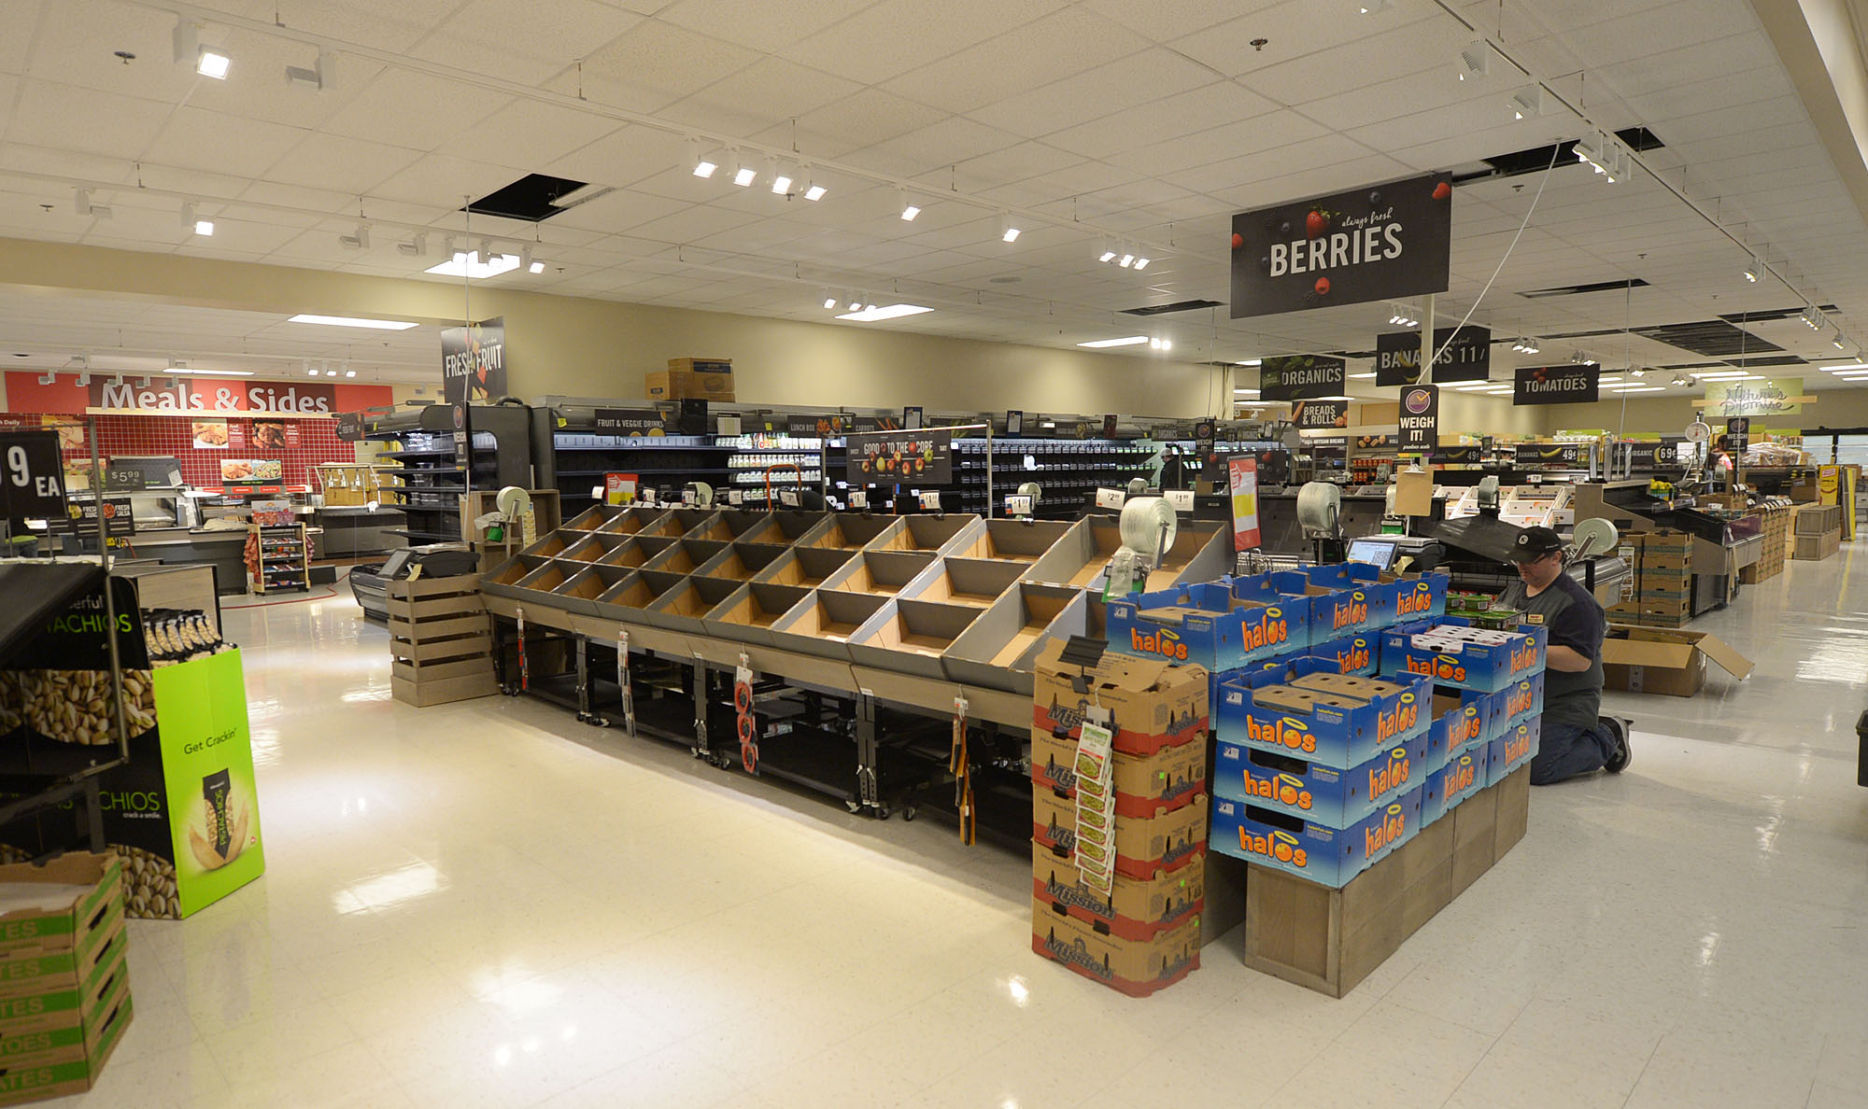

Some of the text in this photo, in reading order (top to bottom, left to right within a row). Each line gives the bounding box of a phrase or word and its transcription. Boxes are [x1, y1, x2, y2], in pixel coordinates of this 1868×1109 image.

[1270, 222, 1403, 278] BERRIES
[445, 344, 502, 378] FRESH FRUIT
[1281, 367, 1342, 386] ORGANICS
[101, 383, 329, 414] Meals & Sides
[1524, 377, 1588, 393] TOMATOES
[597, 418, 615, 428] FRUIT
[616, 420, 622, 428] &
[622, 419, 643, 428] VEGGIE
[1302, 414, 1336, 426] & ROLLS
[1303, 405, 1336, 416] BREADS
[1400, 416, 1435, 429] WEIGH
[887, 442, 896, 454] TO
[896, 441, 909, 454] THE
[1409, 430, 1424, 442] IT!
[35, 476, 61, 498] EA
[1334, 598, 1368, 631] halos
[1397, 587, 1432, 617] halos
[1131, 627, 1188, 660] halos
[1242, 614, 1288, 653] halos
[1337, 644, 1370, 675] halos
[1406, 654, 1467, 683] halos
[1510, 644, 1538, 675] halos
[1246, 714, 1317, 754] halos
[1375, 701, 1418, 745] halos
[183, 727, 237, 755] Get Crackin'
[1243, 769, 1313, 810] halos
[1369, 757, 1410, 801] halos
[1444, 764, 1475, 802] halos
[1238, 825, 1308, 868] halos
[1365, 813, 1405, 860] halos
[1045, 877, 1116, 920] Mission
[1044, 933, 1114, 981] Mission
